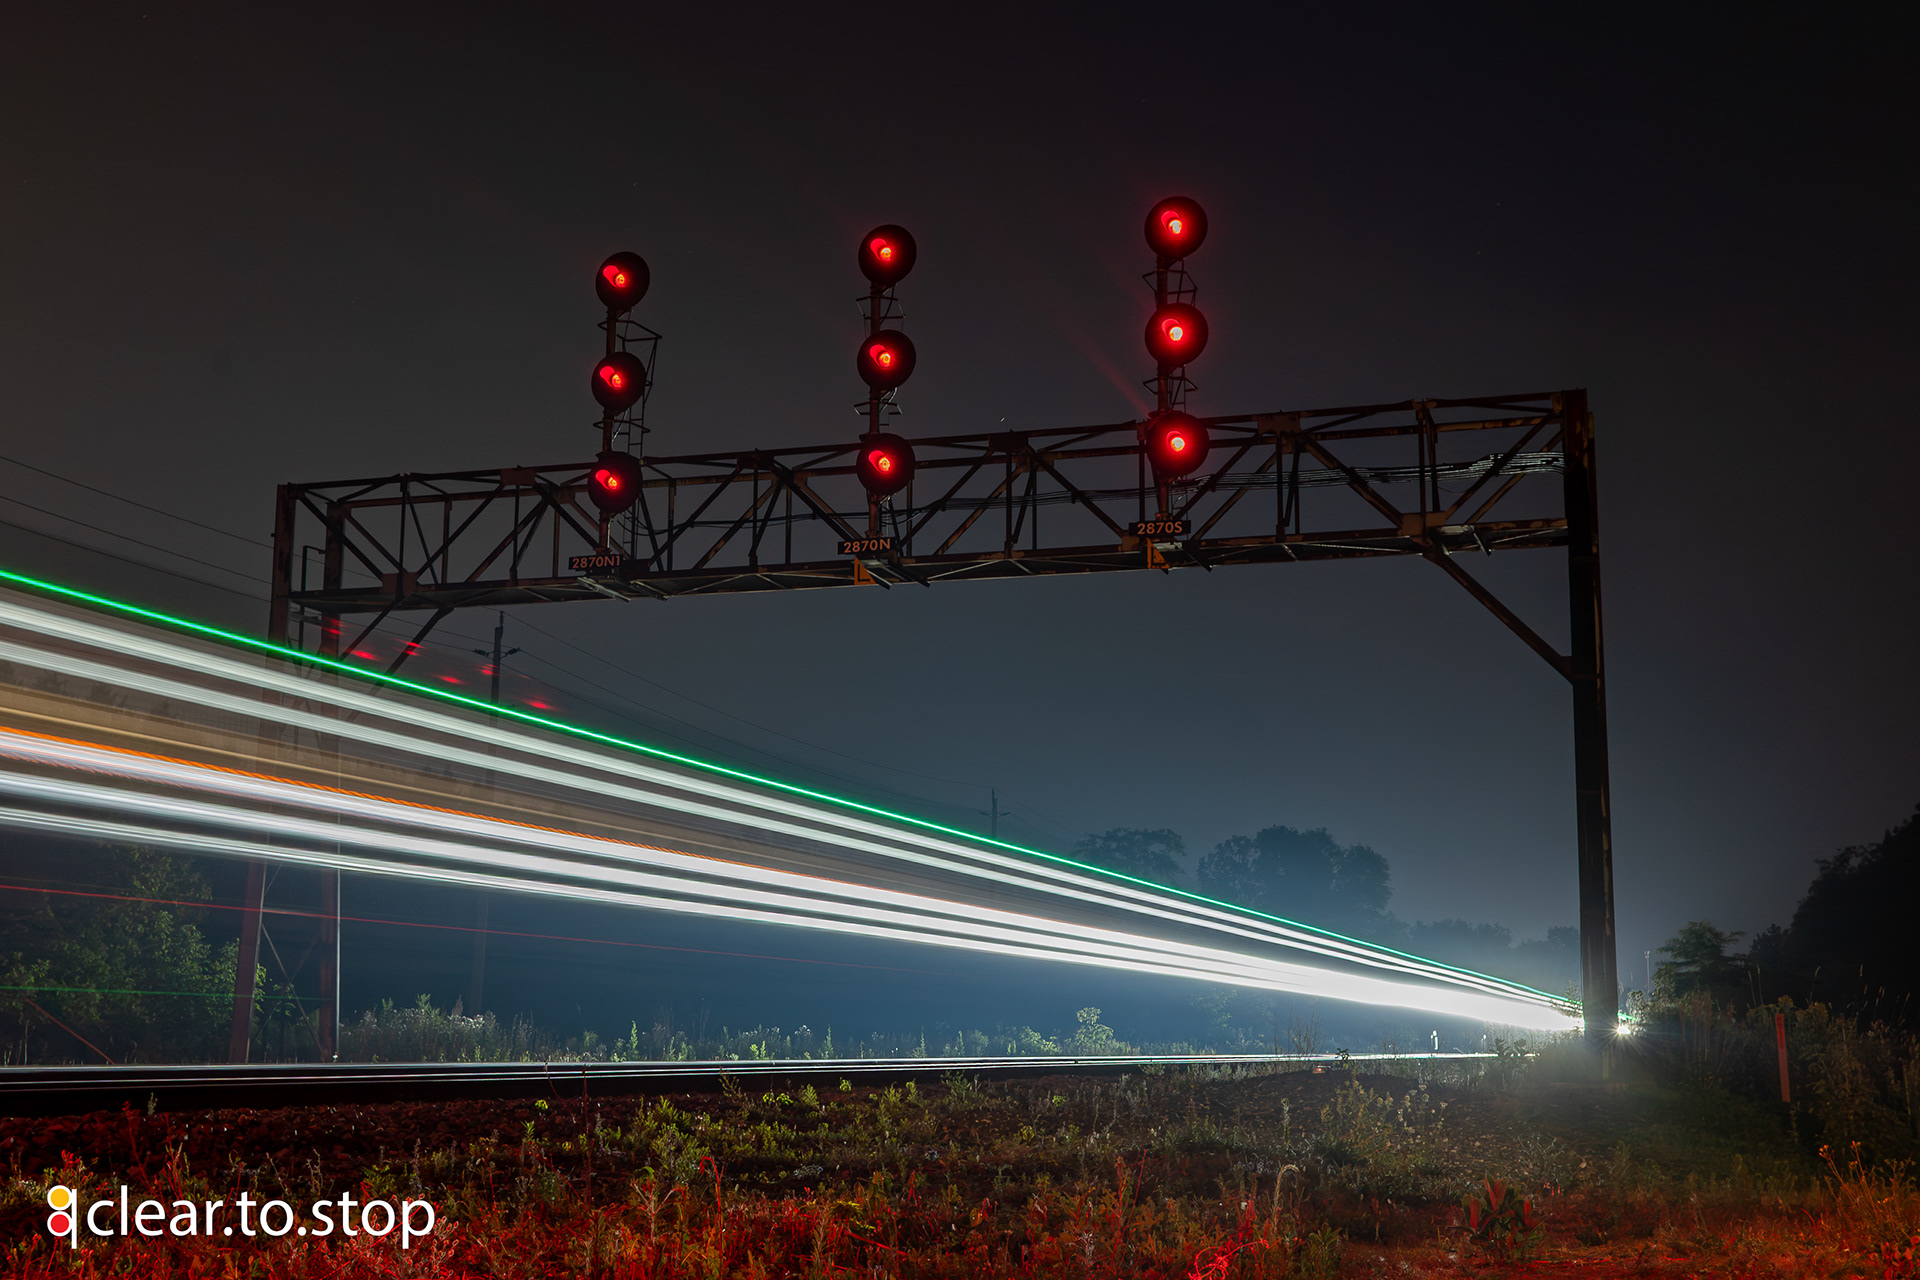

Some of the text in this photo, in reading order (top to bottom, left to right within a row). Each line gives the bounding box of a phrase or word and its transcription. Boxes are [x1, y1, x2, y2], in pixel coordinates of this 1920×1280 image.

[1137, 521, 1183, 535] 2870S
[843, 538, 891, 553] 2870N
[572, 555, 620, 569] 2870N1
